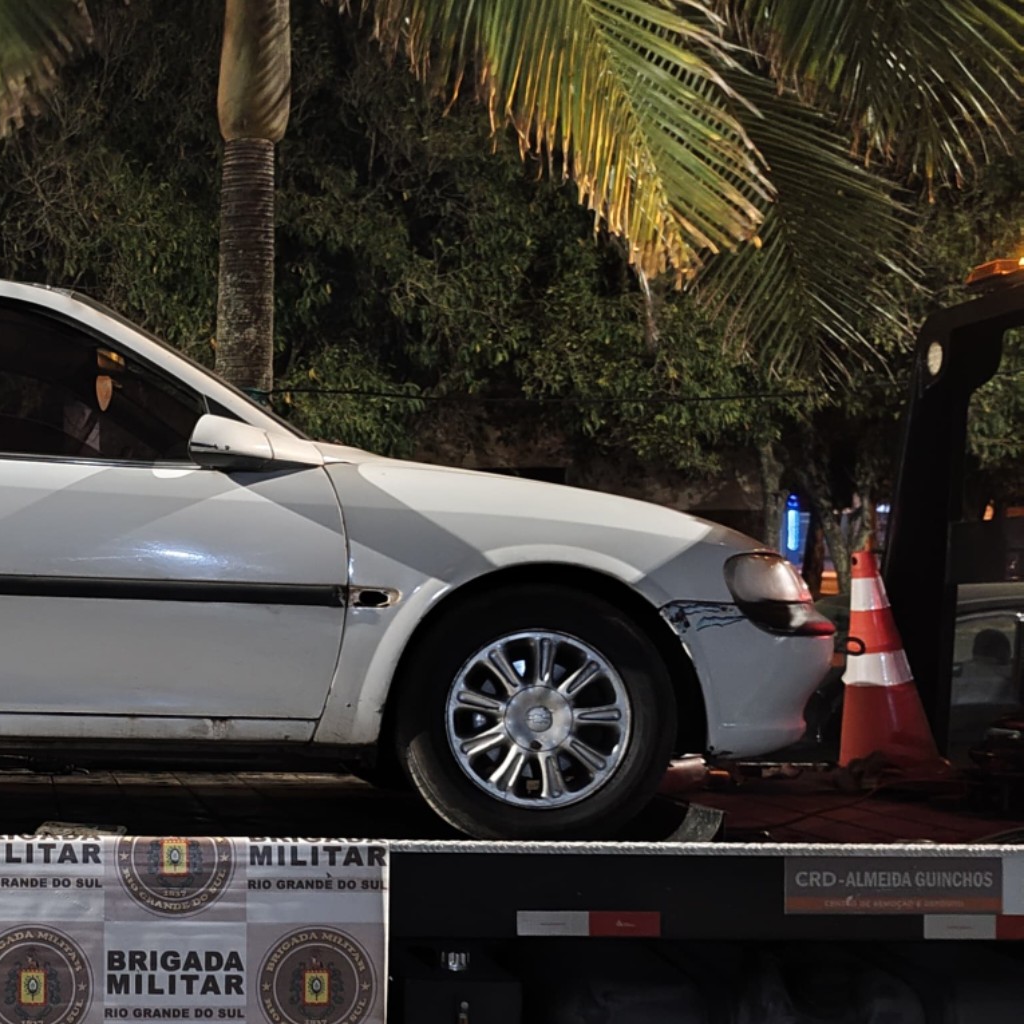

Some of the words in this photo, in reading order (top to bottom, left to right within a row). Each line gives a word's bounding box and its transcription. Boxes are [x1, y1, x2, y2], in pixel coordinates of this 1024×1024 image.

[250, 846, 387, 866] MILITAR
[52, 878, 71, 888] DO
[76, 878, 102, 888] SUL
[124, 869, 139, 894] RIO
[140, 892, 190, 909] GRANDE
[193, 894, 208, 906] DO
[209, 870, 226, 893] SUL
[248, 879, 271, 890] RIO
[277, 879, 333, 890] GRANDE
[338, 880, 356, 890] DO
[361, 880, 388, 890] SUL
[915, 871, 993, 887] GUINCHOS
[37, 932, 82, 971] MILITAR
[107, 951, 244, 972] BRIGADA
[267, 933, 317, 972] BRIGADA
[321, 933, 364, 972] MILITAR
[107, 974, 244, 995] MILITAR
[67, 1000, 83, 1023] SUL
[105, 1008, 128, 1018] RIO
[133, 1008, 189, 1018] GRANDE
[194, 1008, 213, 1018] DO
[219, 1008, 244, 1018] SUL
[264, 998, 280, 1022] RIO
[350, 998, 367, 1022] SUL
